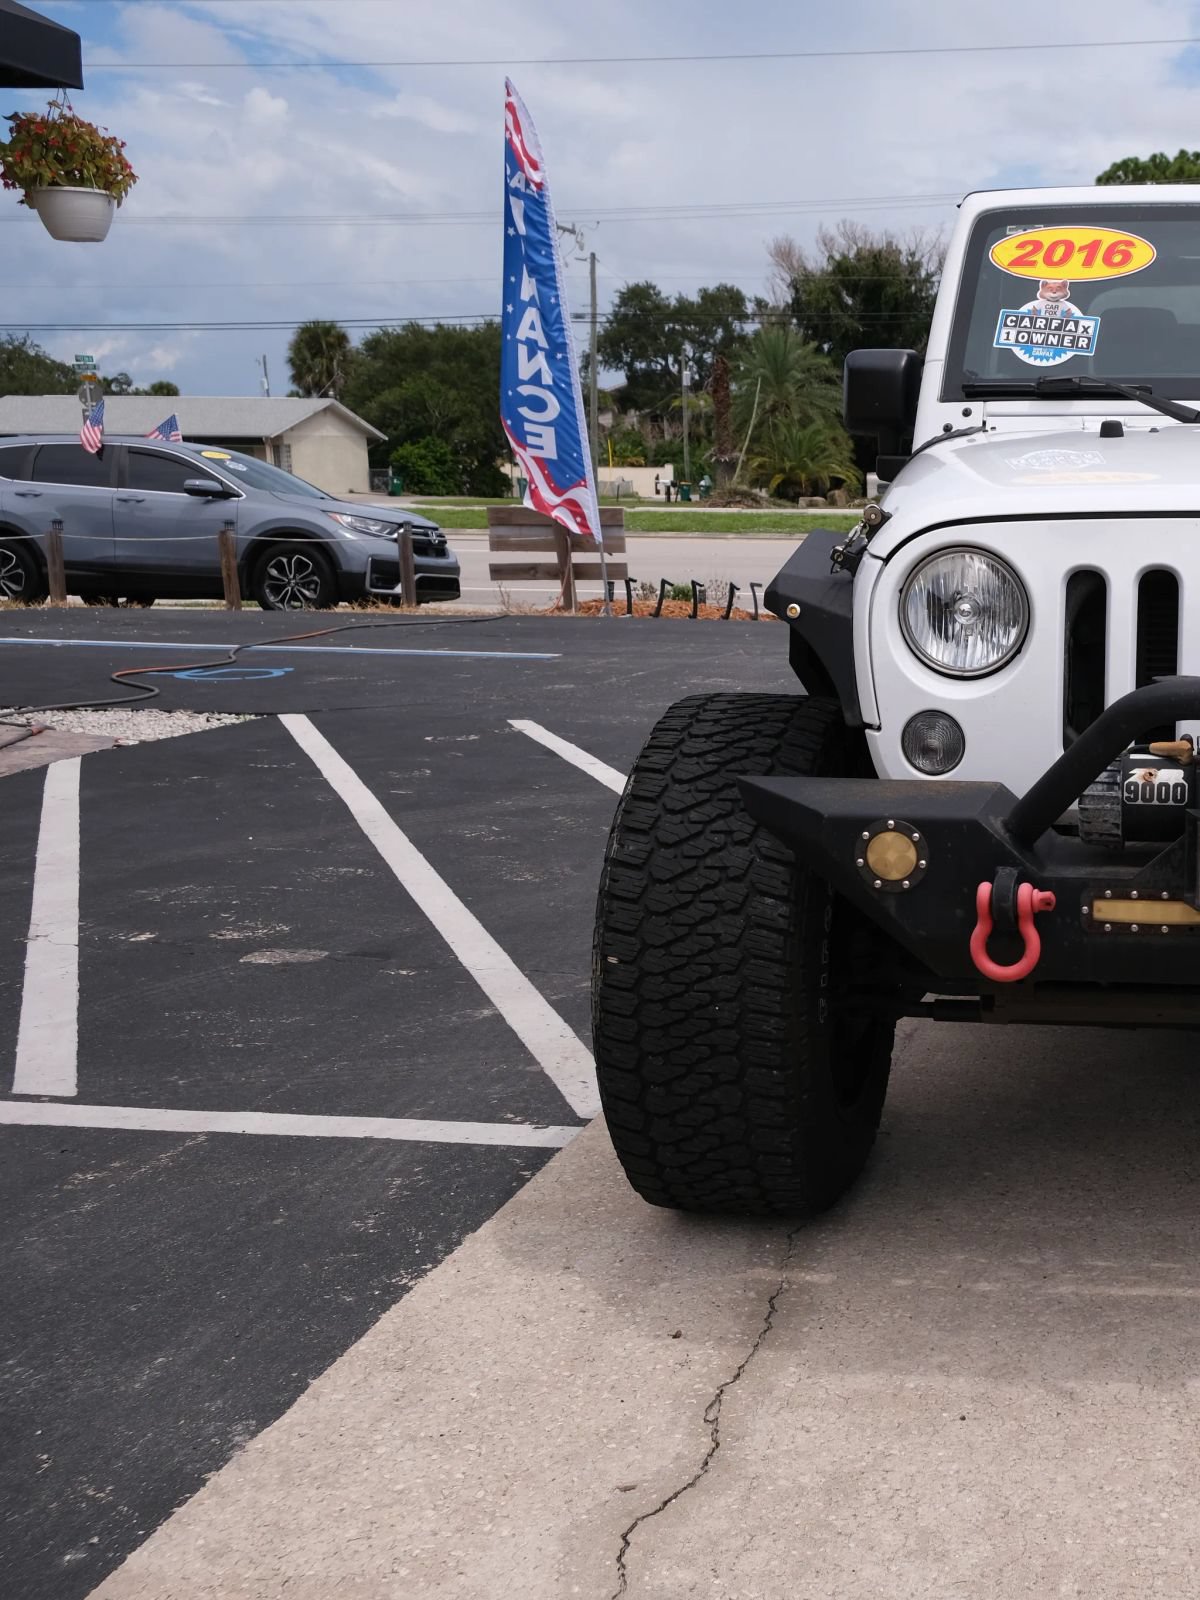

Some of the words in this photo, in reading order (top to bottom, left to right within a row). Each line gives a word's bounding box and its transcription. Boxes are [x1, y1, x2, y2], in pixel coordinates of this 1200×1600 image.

[1007, 239, 1136, 268] 2016
[1006, 316, 1091, 334] CARFAX
[1003, 331, 1012, 341] 1
[1018, 332, 1089, 348] OWNER
[1124, 780, 1188, 805] 9000
